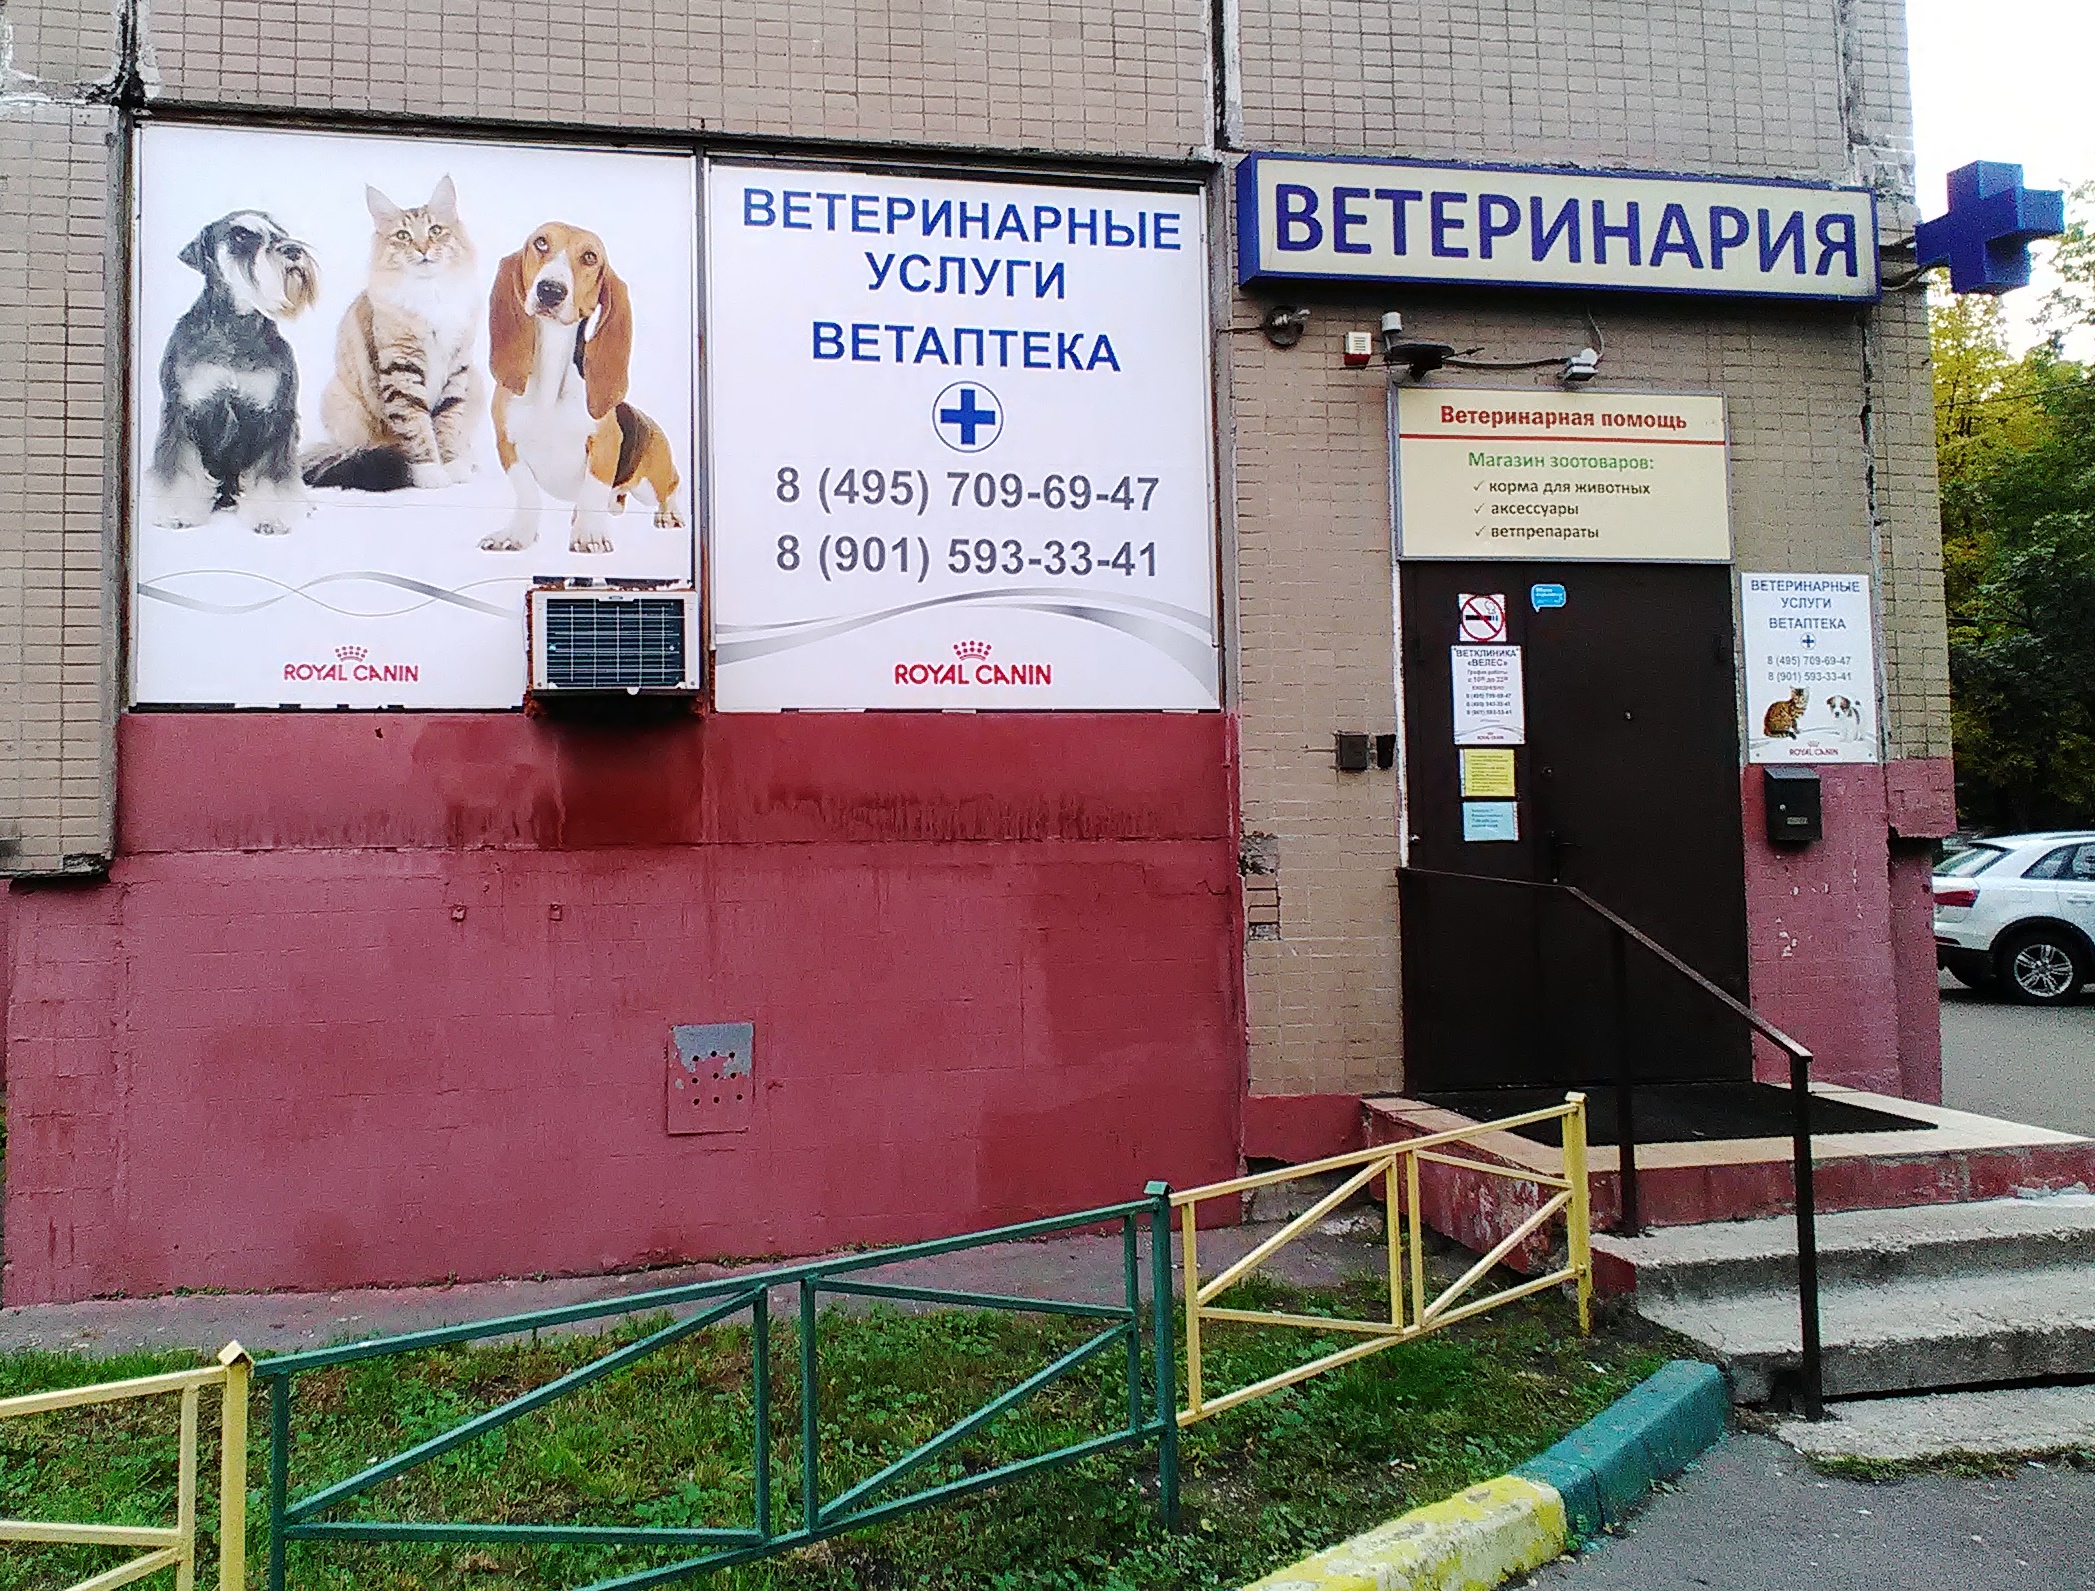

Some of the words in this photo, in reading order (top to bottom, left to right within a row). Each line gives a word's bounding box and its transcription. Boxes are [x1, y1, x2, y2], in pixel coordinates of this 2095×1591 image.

[743, 188, 1182, 251] ВЕТЕРИНАРНЫЕ
[1274, 182, 1859, 278] ВЕТЕРИНАРИЯ
[866, 252, 1066, 299] УСЛУГИ
[812, 321, 1122, 372] ВЕТАПТЕКА
[1440, 405, 1595, 428] Ветеринарная
[1601, 412, 1687, 431] помощь
[1468, 452, 1545, 468] Магазин
[1550, 457, 1655, 472] зоотоваров:
[776, 467, 800, 504] 8
[818, 467, 930, 514] (495)
[946, 471, 1160, 511] 709-69-47
[1489, 483, 1539, 496] корма
[1542, 484, 1571, 496] для
[1574, 484, 1651, 496] животных
[1491, 505, 1579, 516] аксессуары
[1491, 527, 1599, 540] ветпрепараты
[776, 534, 800, 571] 8
[818, 534, 930, 582] (901)
[947, 538, 1158, 577] 593-33-41
[1750, 579, 1861, 593] ВЕТЕРИНАРНЫЕ
[1780, 597, 1832, 609] УСЛУГИ
[1768, 617, 1847, 630] ВЕТАПТЕКА
[1766, 655, 1773, 666] 8
[1775, 655, 1801, 668] (495)
[1803, 656, 1852, 666] 709-69-47
[283, 664, 347, 682] ROYAL
[353, 664, 419, 682] CANIN
[894, 664, 969, 685] ROYAL
[974, 664, 1052, 685] CANIN
[1767, 671, 1774, 682] 8
[1776, 671, 1802, 683] (901)
[1804, 671, 1853, 682] 593-33-41
